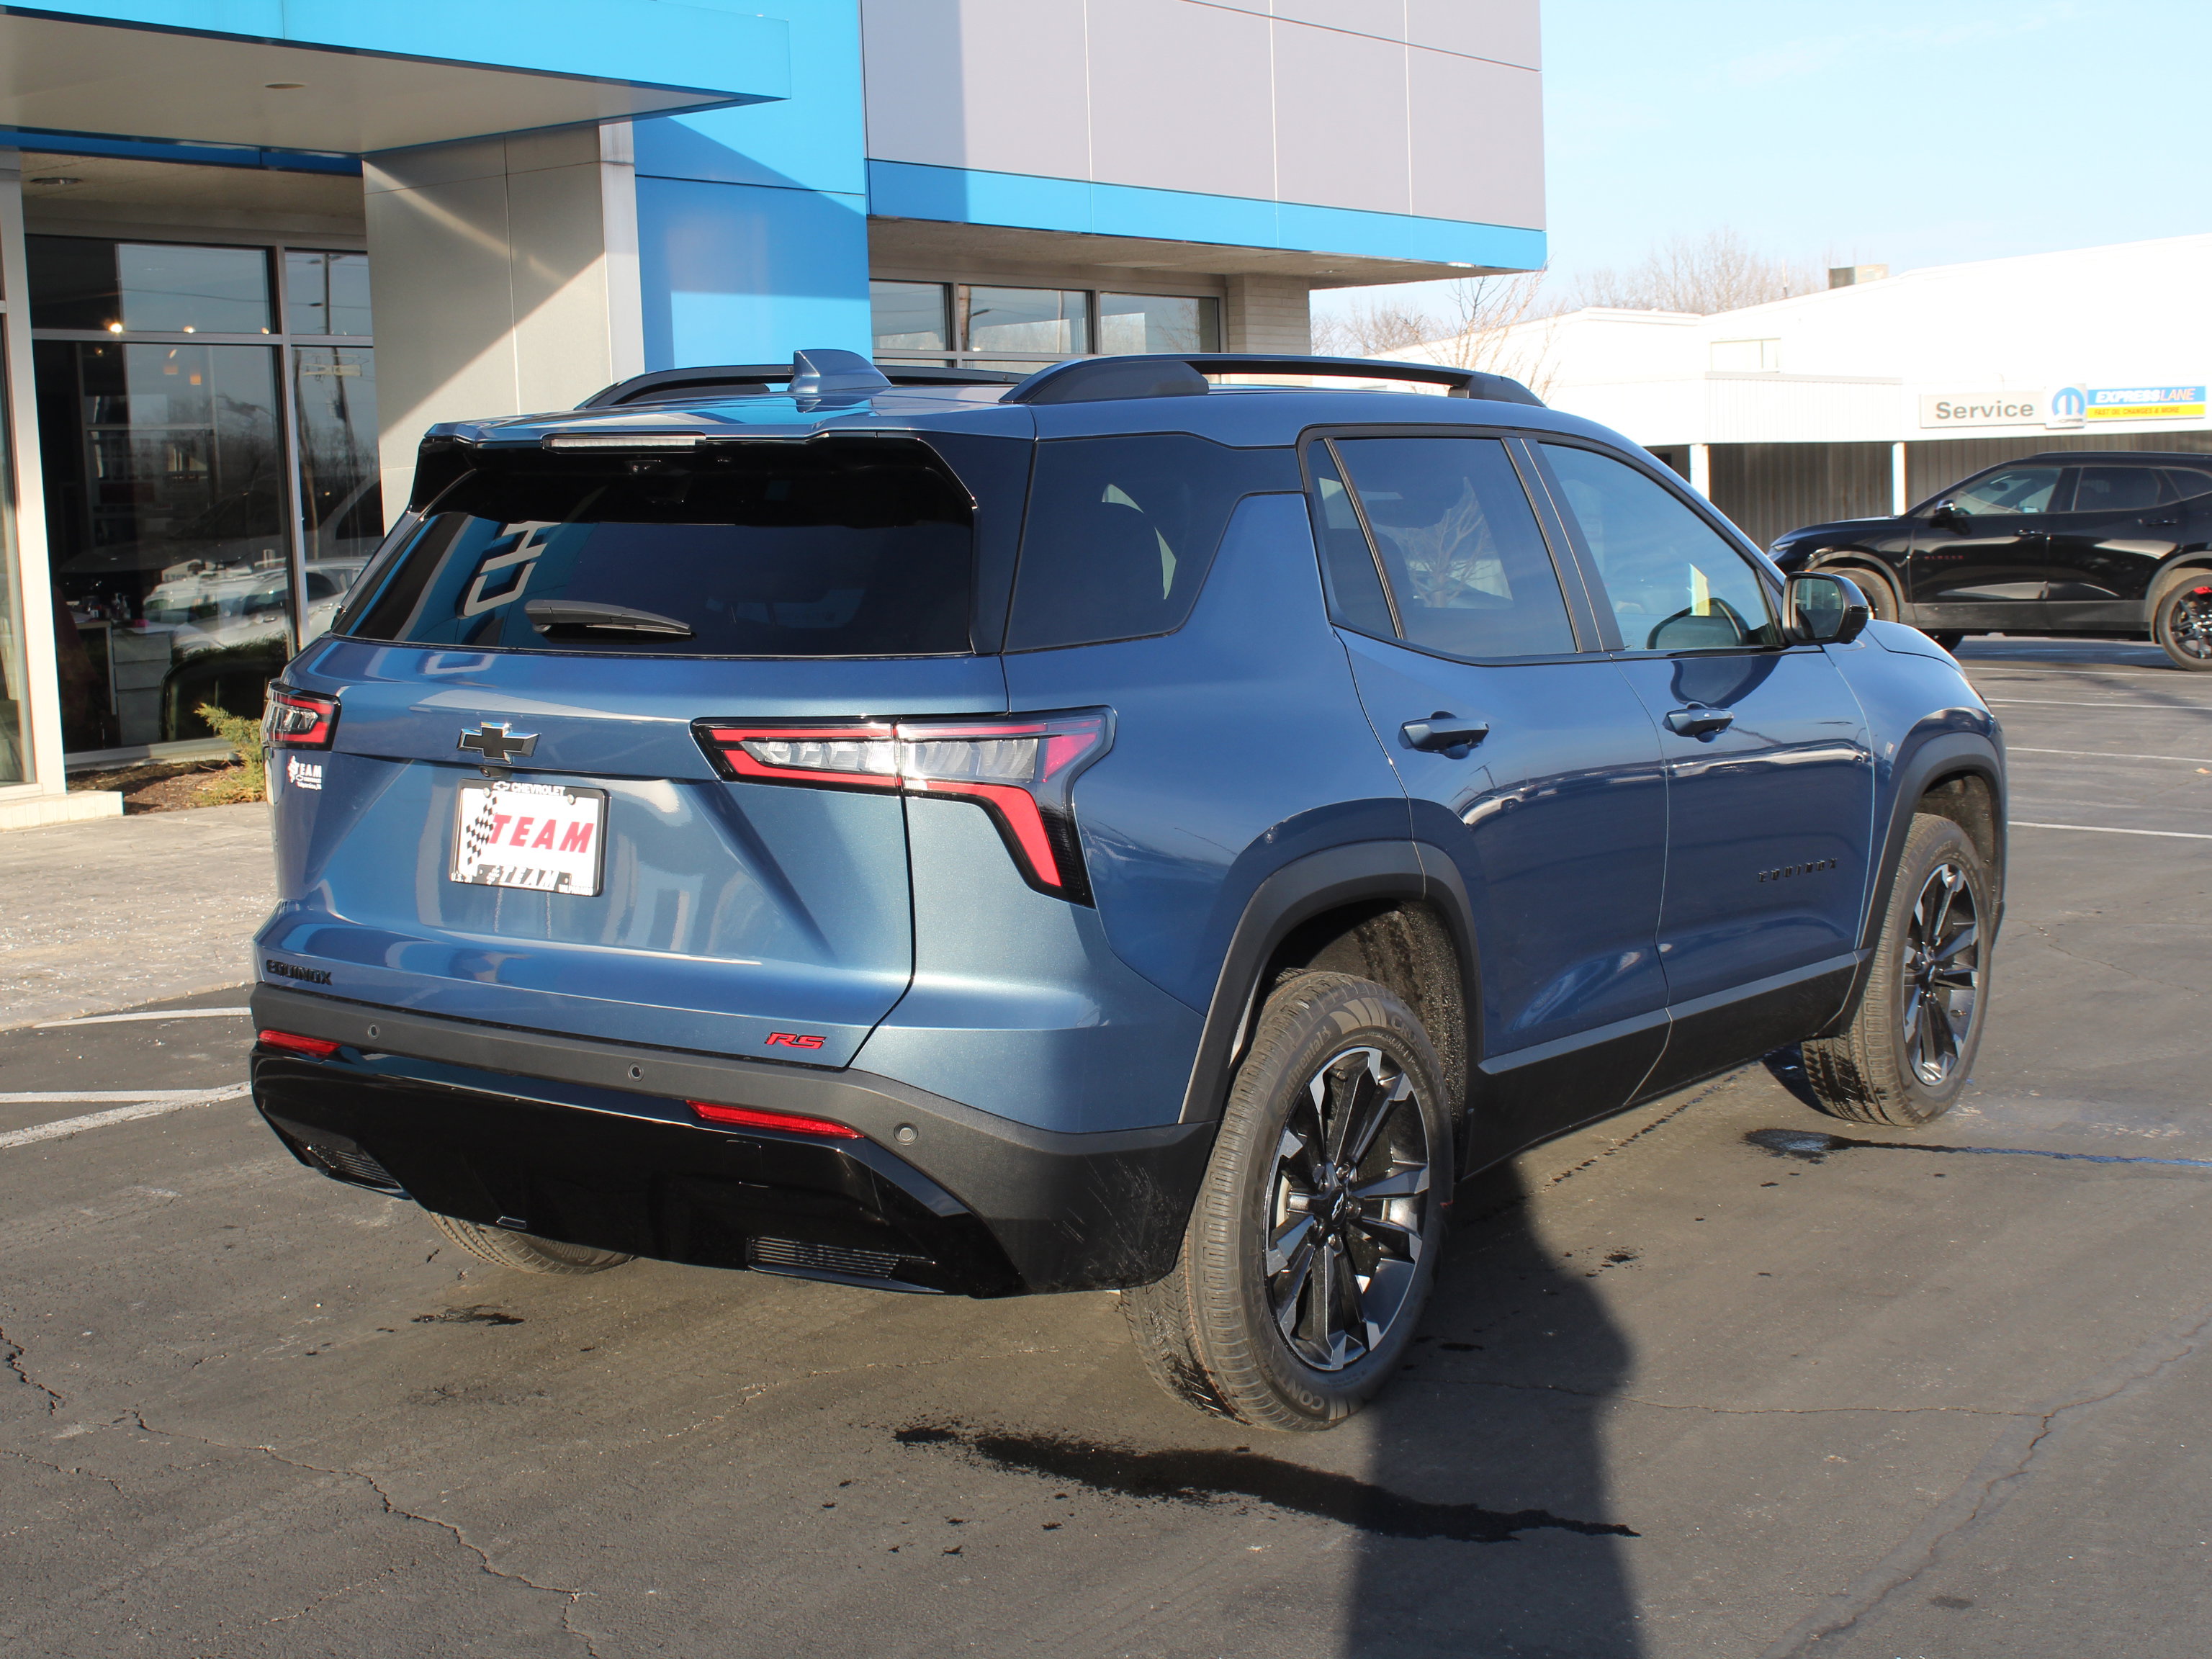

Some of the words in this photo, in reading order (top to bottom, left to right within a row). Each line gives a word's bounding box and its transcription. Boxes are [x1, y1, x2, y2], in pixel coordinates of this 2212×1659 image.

[1936, 400, 2034, 420] Service
[511, 782, 566, 796] CHEVROLET
[489, 814, 594, 853] TEAM
[499, 866, 559, 890] TEAM
[266, 959, 333, 986] EQUINOX
[764, 1031, 827, 1050] RS
